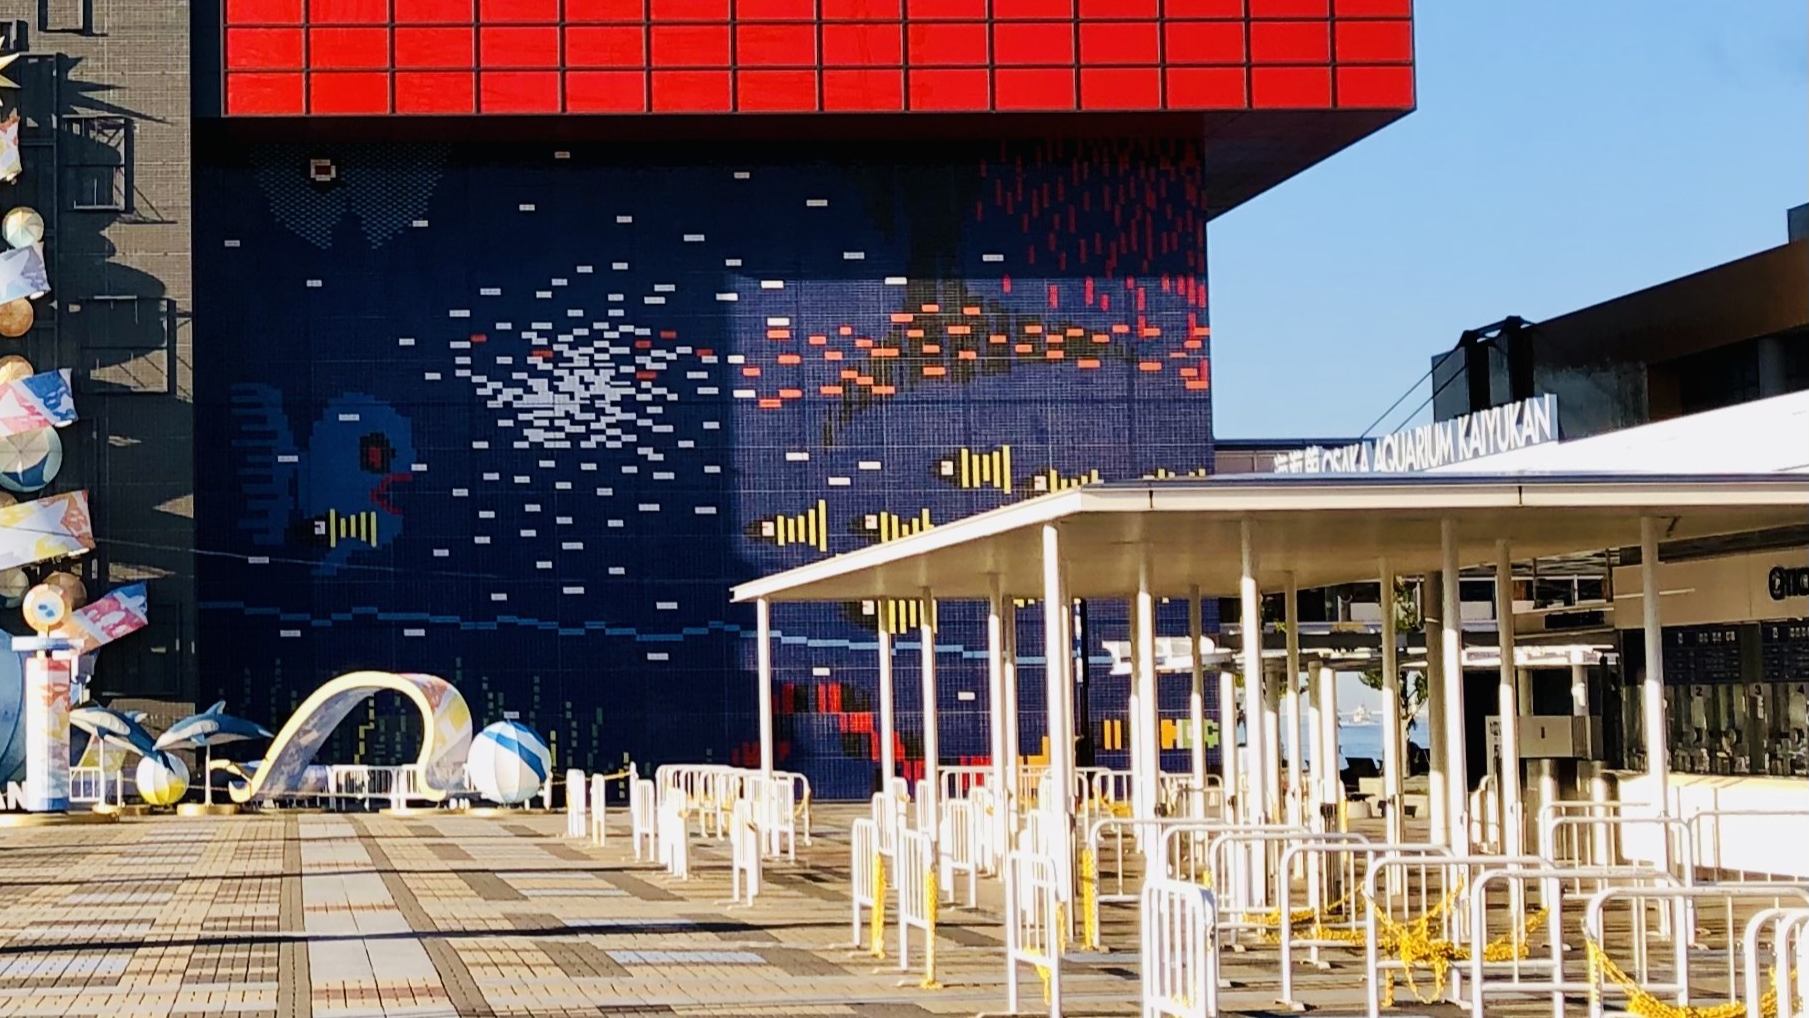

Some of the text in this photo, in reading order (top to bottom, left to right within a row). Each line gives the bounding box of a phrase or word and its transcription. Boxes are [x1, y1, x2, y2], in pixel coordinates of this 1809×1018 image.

[1322, 441, 1370, 473] OSAKA
[1374, 419, 1455, 473] AQUARIUM
[1458, 393, 1552, 461] KAIYUKAN
[1695, 686, 1703, 696] 2
[1754, 684, 1762, 695] 3
